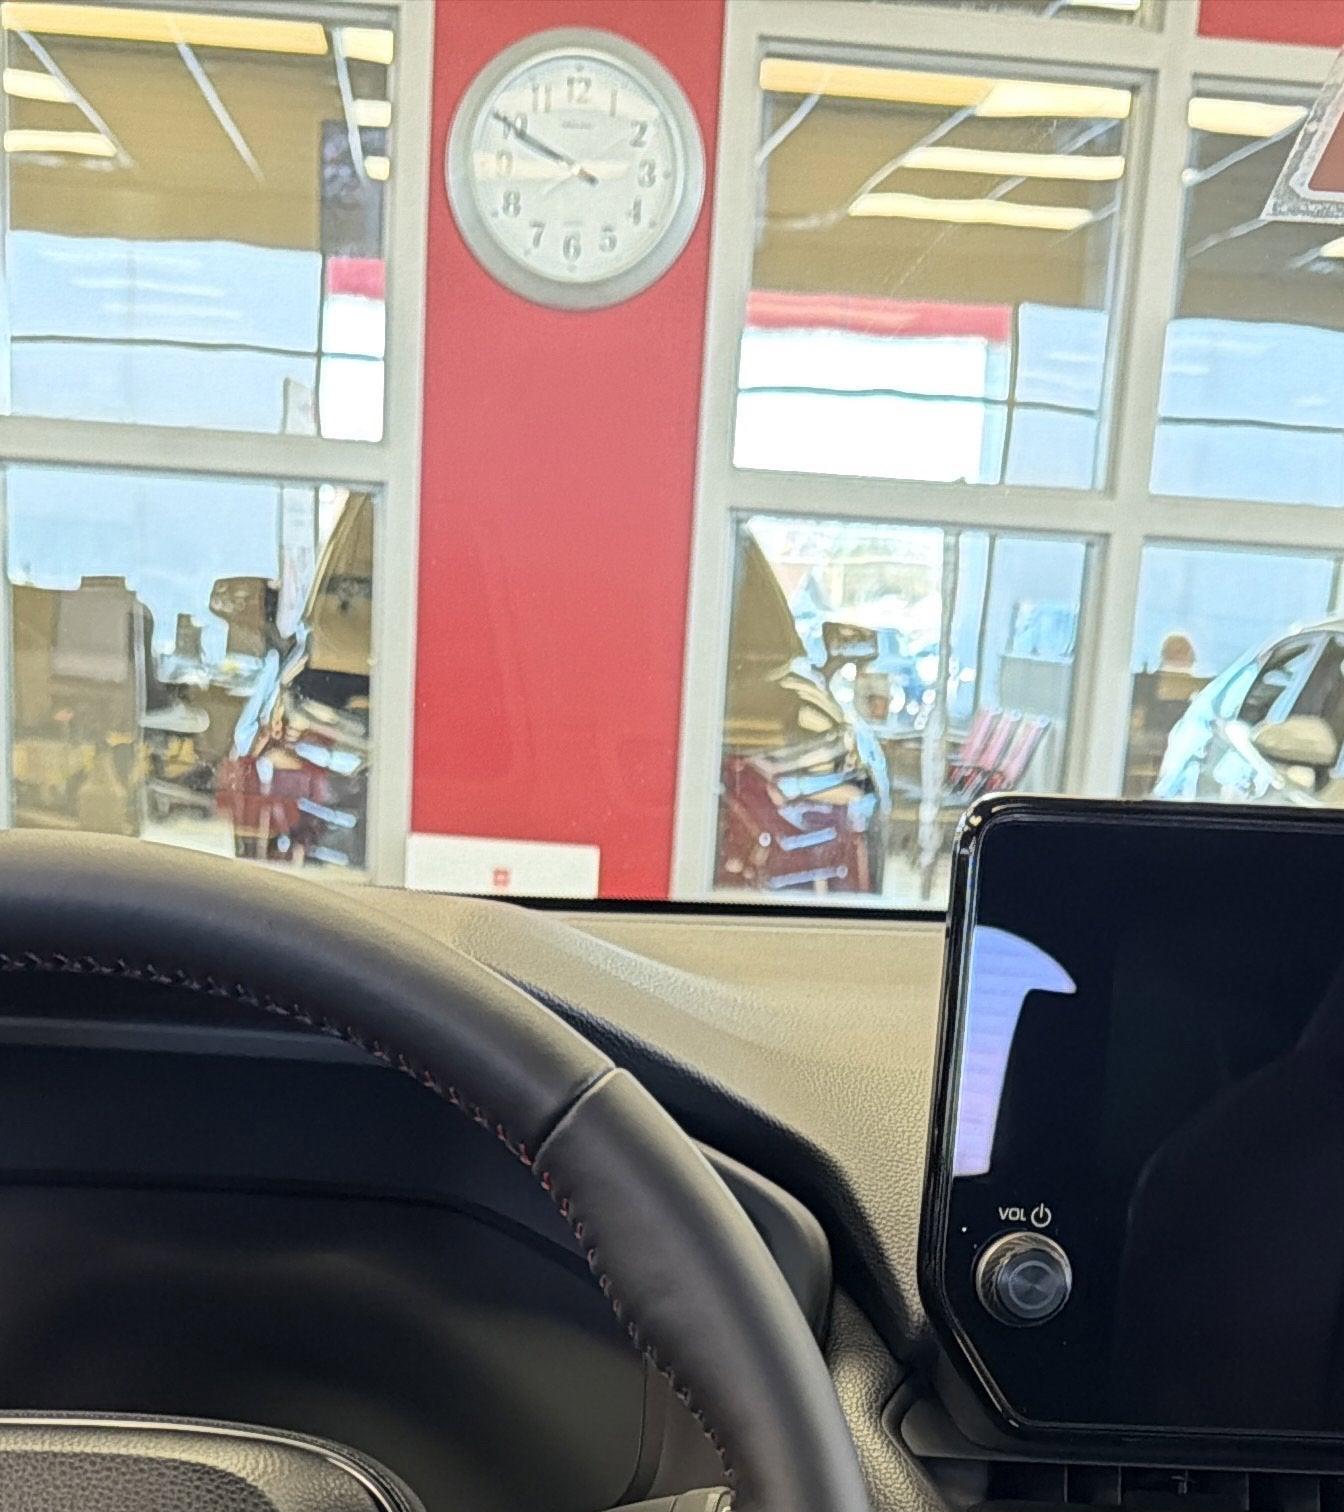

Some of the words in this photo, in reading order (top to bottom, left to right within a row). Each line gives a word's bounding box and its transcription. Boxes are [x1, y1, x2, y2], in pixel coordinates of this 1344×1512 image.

[532, 83, 552, 113] 11
[567, 76, 591, 104] 12
[630, 120, 648, 148] 2
[637, 158, 657, 189] 3
[502, 189, 521, 218] 8
[529, 219, 546, 249] 7
[562, 230, 582, 261] 6
[598, 224, 618, 253] 5
[998, 1206, 1026, 1221] VOL
